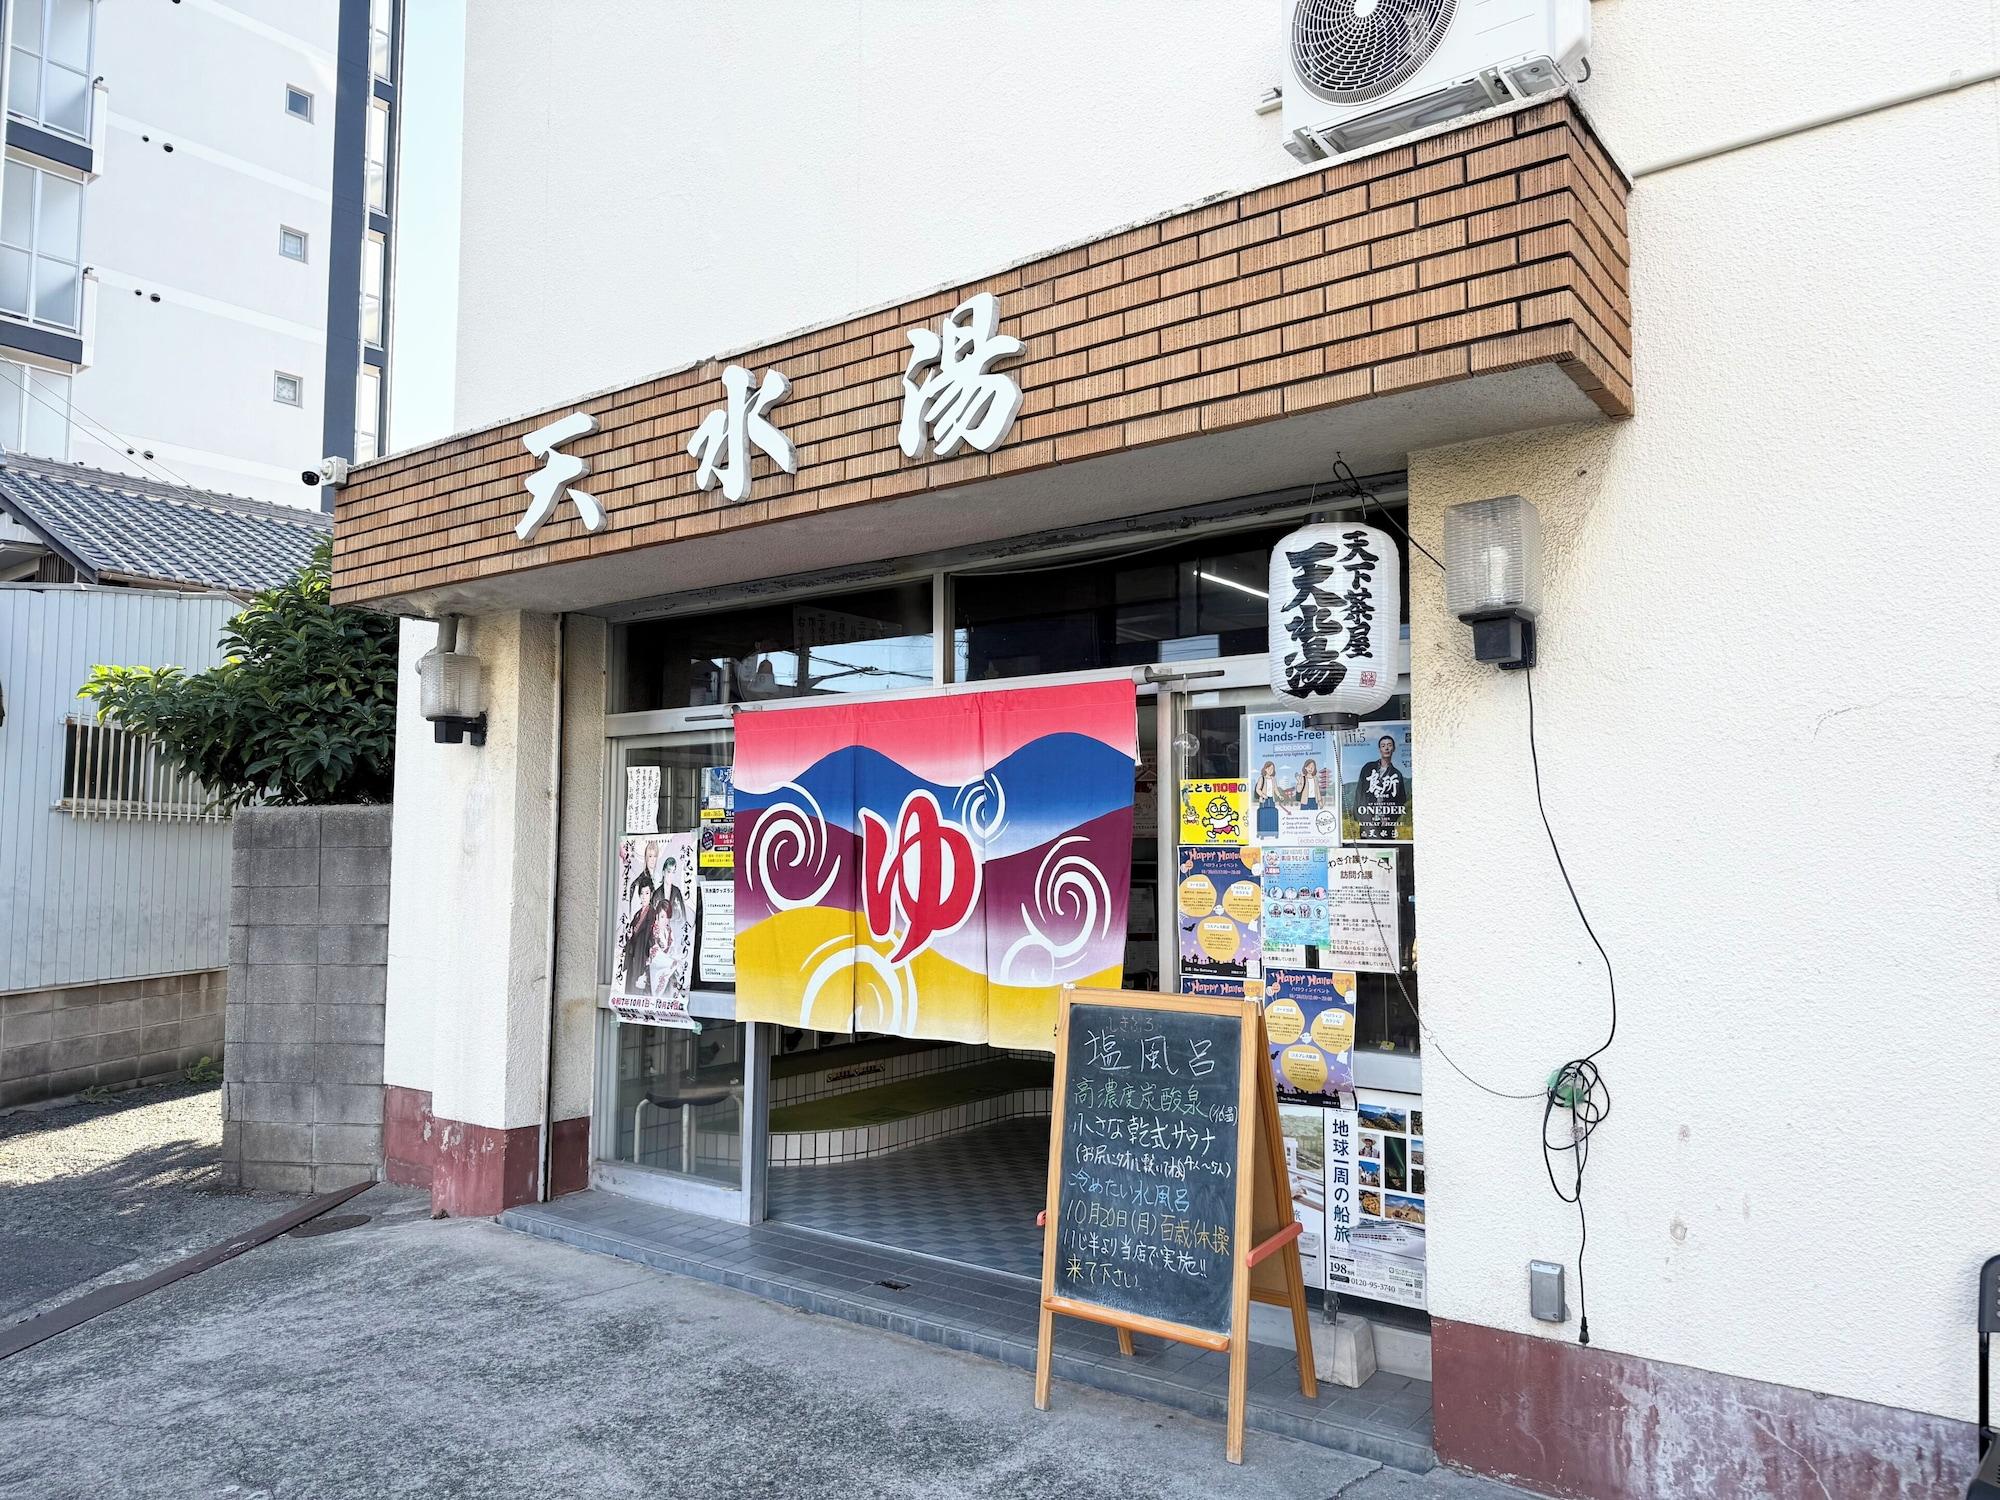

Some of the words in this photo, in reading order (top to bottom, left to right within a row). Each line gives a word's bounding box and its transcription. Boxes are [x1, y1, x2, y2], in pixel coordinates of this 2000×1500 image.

[514, 290, 1026, 543] 天水湯
[1337, 530, 1379, 660] 天下茶屋
[1280, 541, 1348, 699] 天水湯
[1257, 720, 1287, 731] Enjoy
[1259, 730, 1325, 742] Hands-Free!
[1358, 805, 1406, 815] ONEDER
[1189, 849, 1216, 862] Happy
[861, 792, 979, 966] ゆ
[1191, 980, 1218, 994] Happy
[1273, 971, 1306, 986] Happy
[1084, 1030, 1214, 1076] 塩風呂
[1073, 1113, 1216, 1157] 小さな乾式サウナ
[1068, 1167, 1190, 1213] 冷めたい水風呂
[1333, 1118, 1350, 1243] 地球一周の船旅
[1066, 1253, 1139, 1288] 来て下さい
[1351, 1277, 1396, 1293] 0120-95-3740
